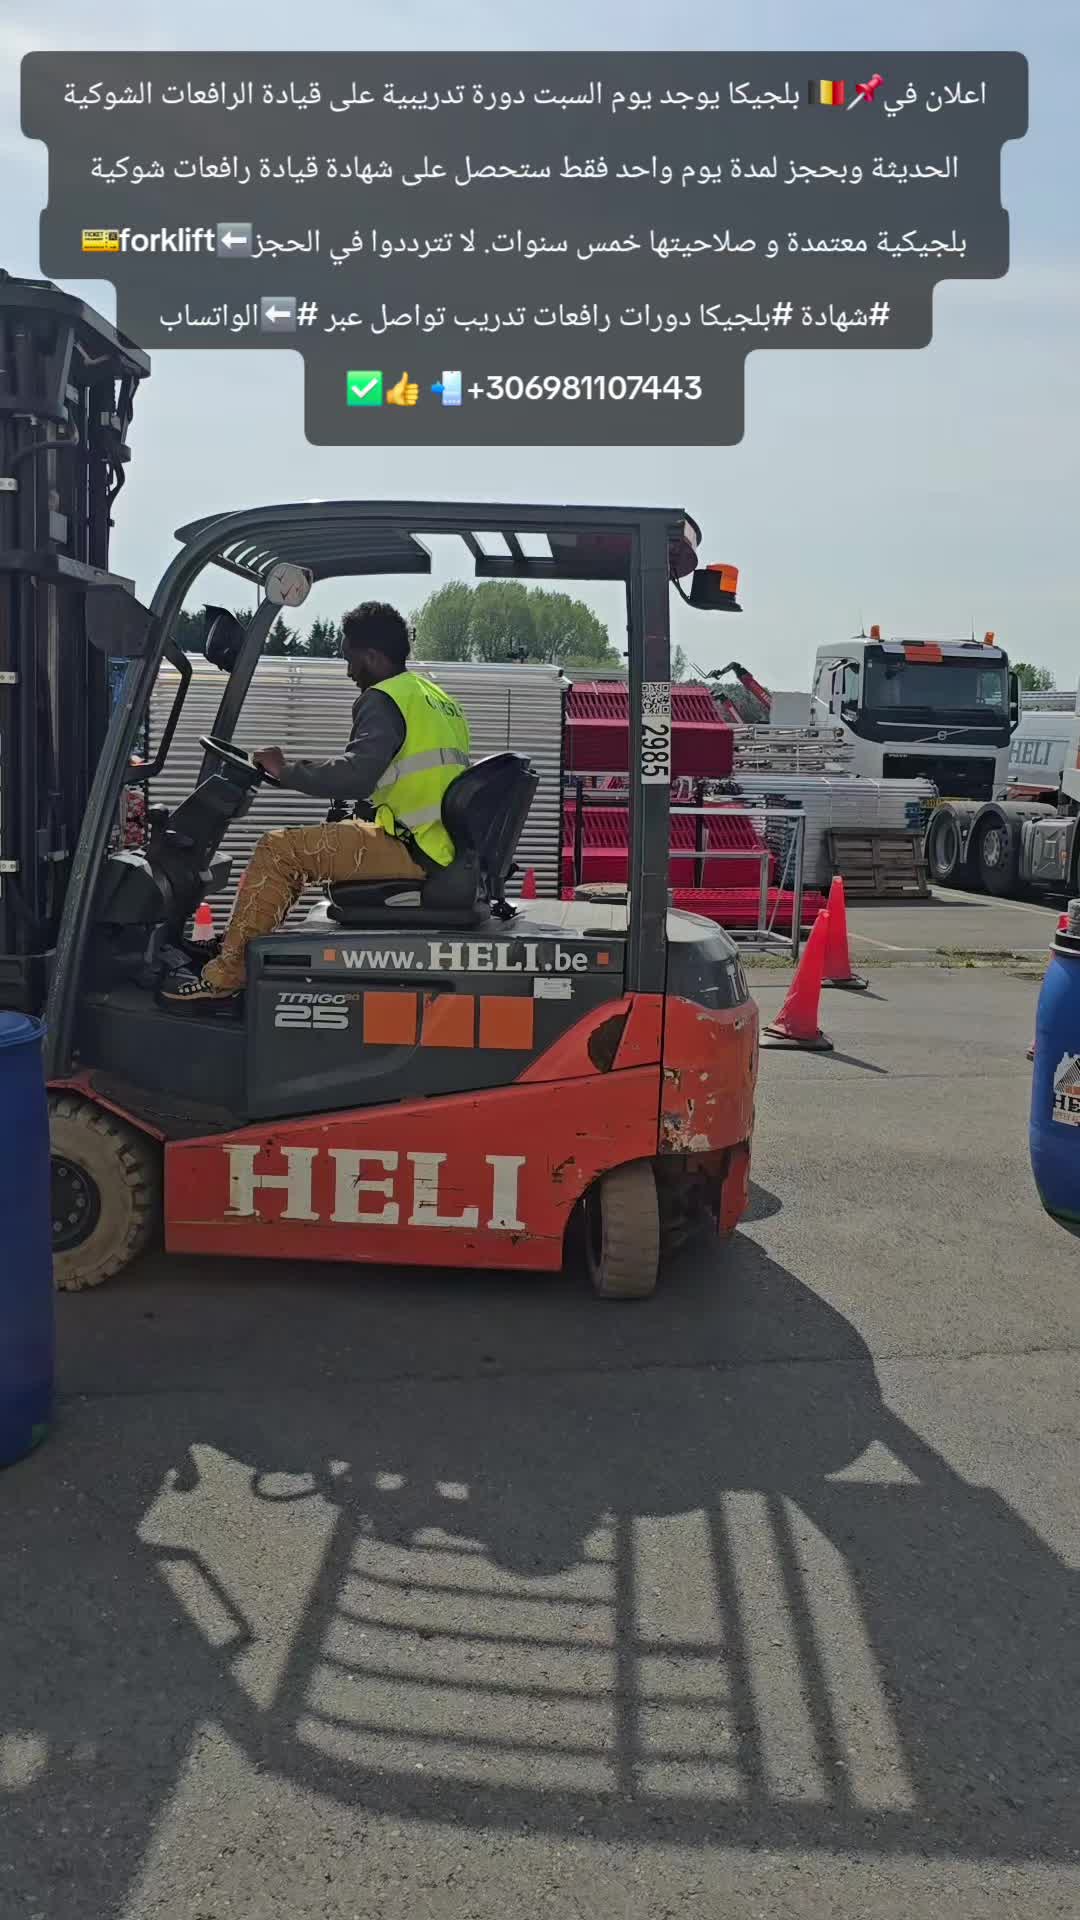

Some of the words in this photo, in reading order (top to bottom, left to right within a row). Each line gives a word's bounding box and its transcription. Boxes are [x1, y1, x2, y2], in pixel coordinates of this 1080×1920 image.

[642, 724, 670, 777] 2985
[1008, 741, 1053, 766] HELI
[342, 942, 589, 972] www.HELI.be
[274, 1004, 349, 1030] 25
[222, 1144, 526, 1230] HELI
